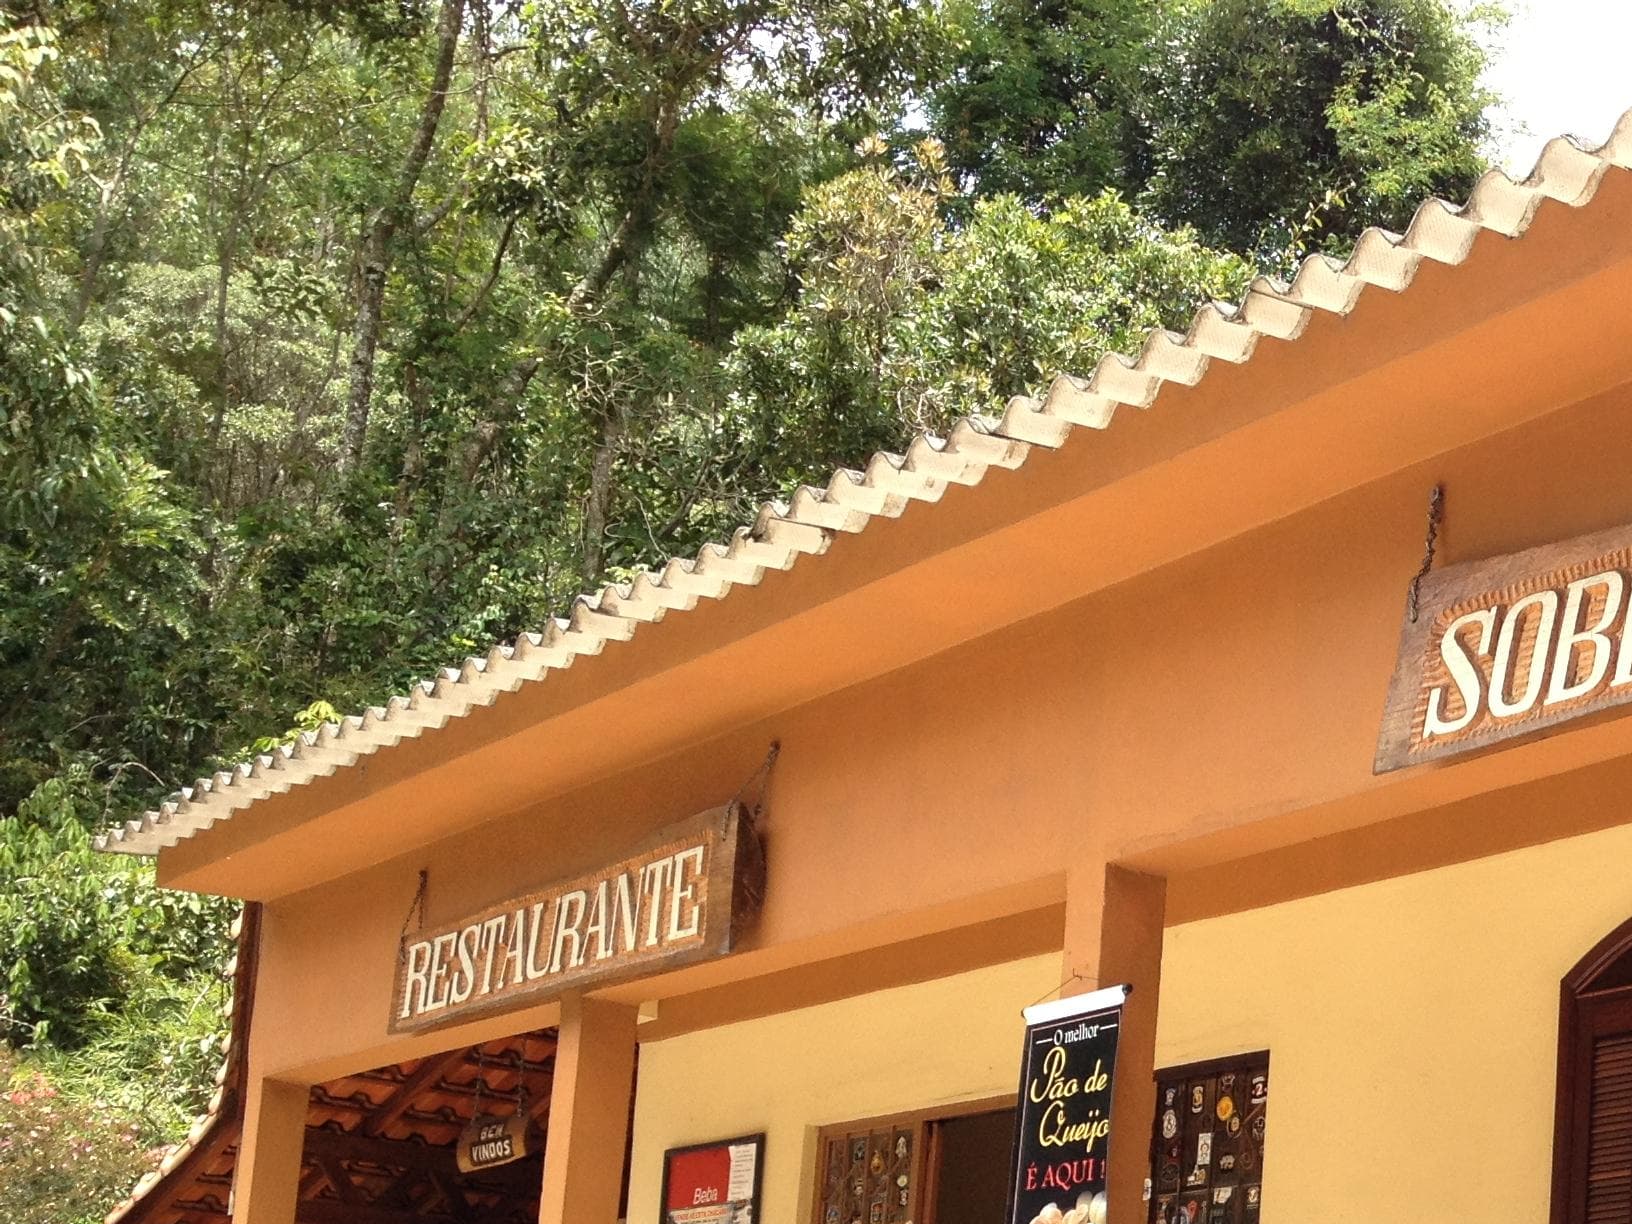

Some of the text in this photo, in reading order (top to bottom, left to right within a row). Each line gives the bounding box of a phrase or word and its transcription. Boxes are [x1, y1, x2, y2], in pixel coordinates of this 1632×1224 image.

[400, 846, 705, 1019] RESTAURANTE
[1053, 1023, 1100, 1046] O melhor
[1030, 1046, 1108, 1103] Pão de
[480, 1123, 505, 1140] BEM
[1039, 1100, 1110, 1153] Queijo
[472, 1139, 512, 1162] VINDOS
[1026, 1161, 1038, 1190] É
[1041, 1158, 1096, 1191] AQUI
[692, 1186, 718, 1204] Beba
